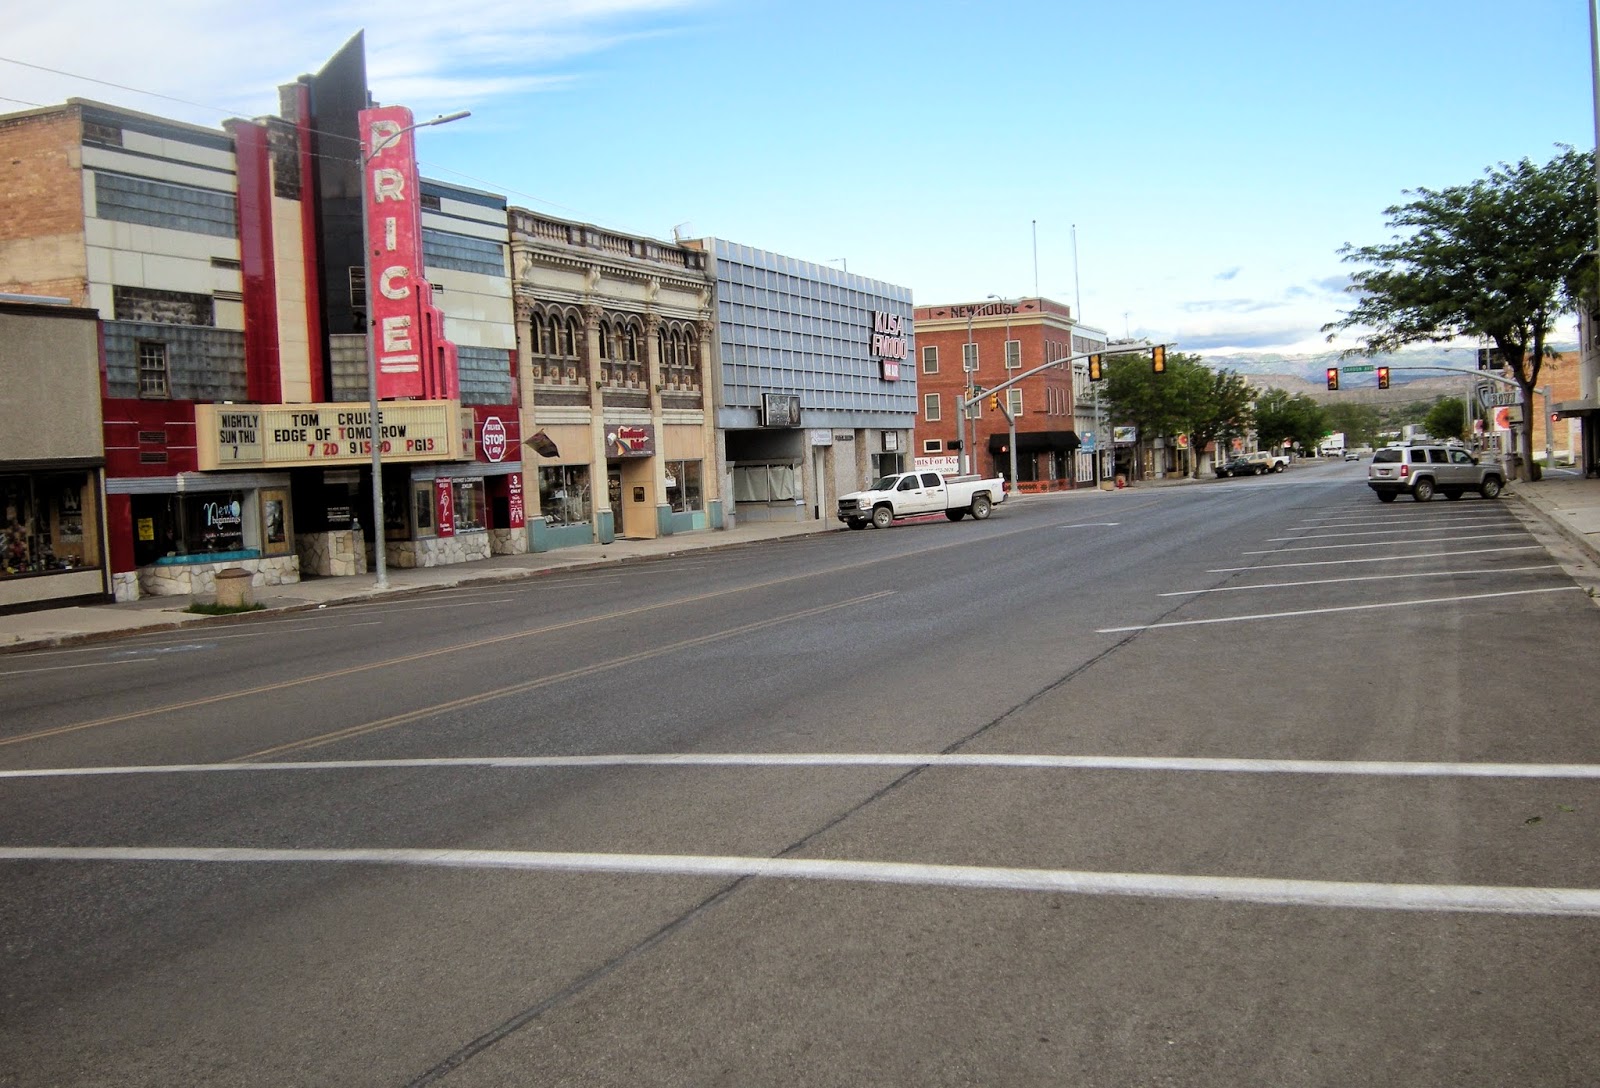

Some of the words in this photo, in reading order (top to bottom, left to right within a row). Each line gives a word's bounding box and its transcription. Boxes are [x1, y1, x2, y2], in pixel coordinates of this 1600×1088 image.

[370, 120, 412, 353] PRICE
[222, 415, 258, 428] NIGHTLY
[292, 414, 319, 427] TOM
[220, 430, 237, 444] SUN
[238, 430, 256, 444] THU
[274, 429, 307, 443] EDGE
[315, 428, 331, 441] OF
[485, 434, 504, 445] STOP
[232, 446, 239, 459] 7
[308, 444, 315, 457] 7
[323, 442, 339, 456] 2D
[929, 456, 944, 465] For
[512, 475, 518, 485] 3
